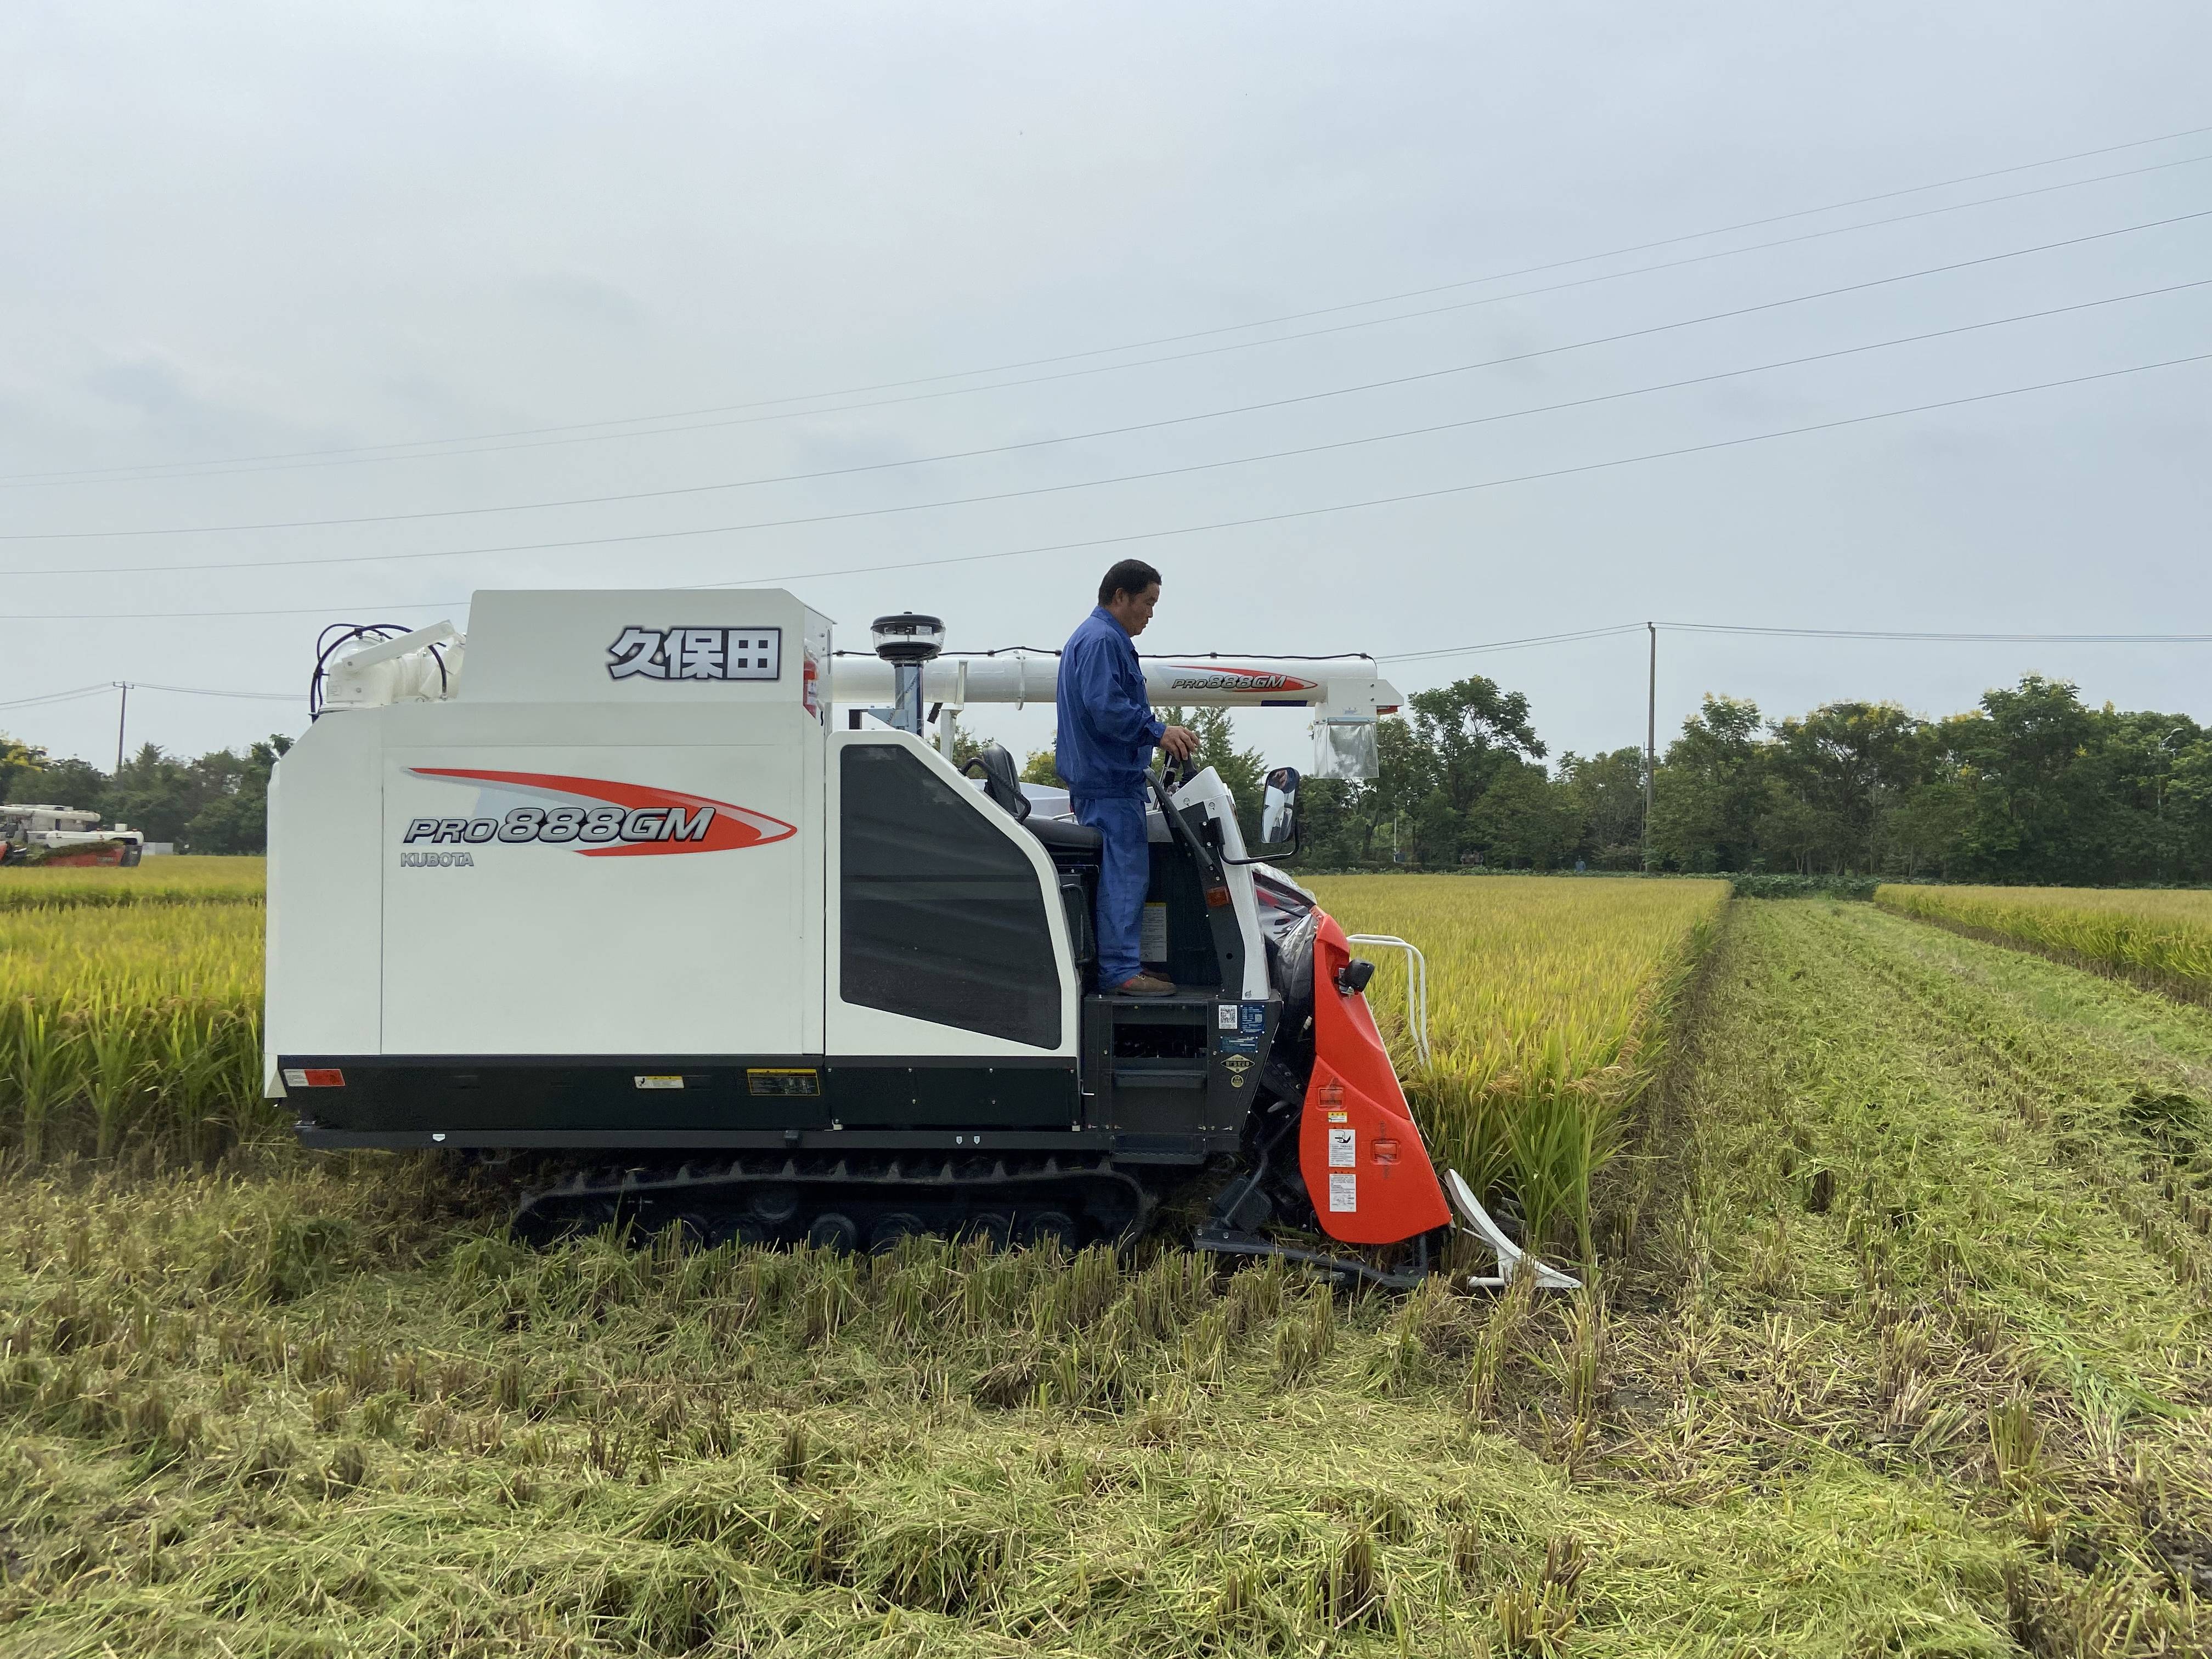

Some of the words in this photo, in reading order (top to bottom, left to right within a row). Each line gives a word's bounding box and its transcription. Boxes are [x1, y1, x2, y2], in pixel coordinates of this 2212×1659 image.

[608, 628, 781, 680] 久保田
[1172, 675, 1286, 689] PRO888GM
[403, 807, 716, 844] PRO888GM
[400, 852, 474, 867] KUBOTA
